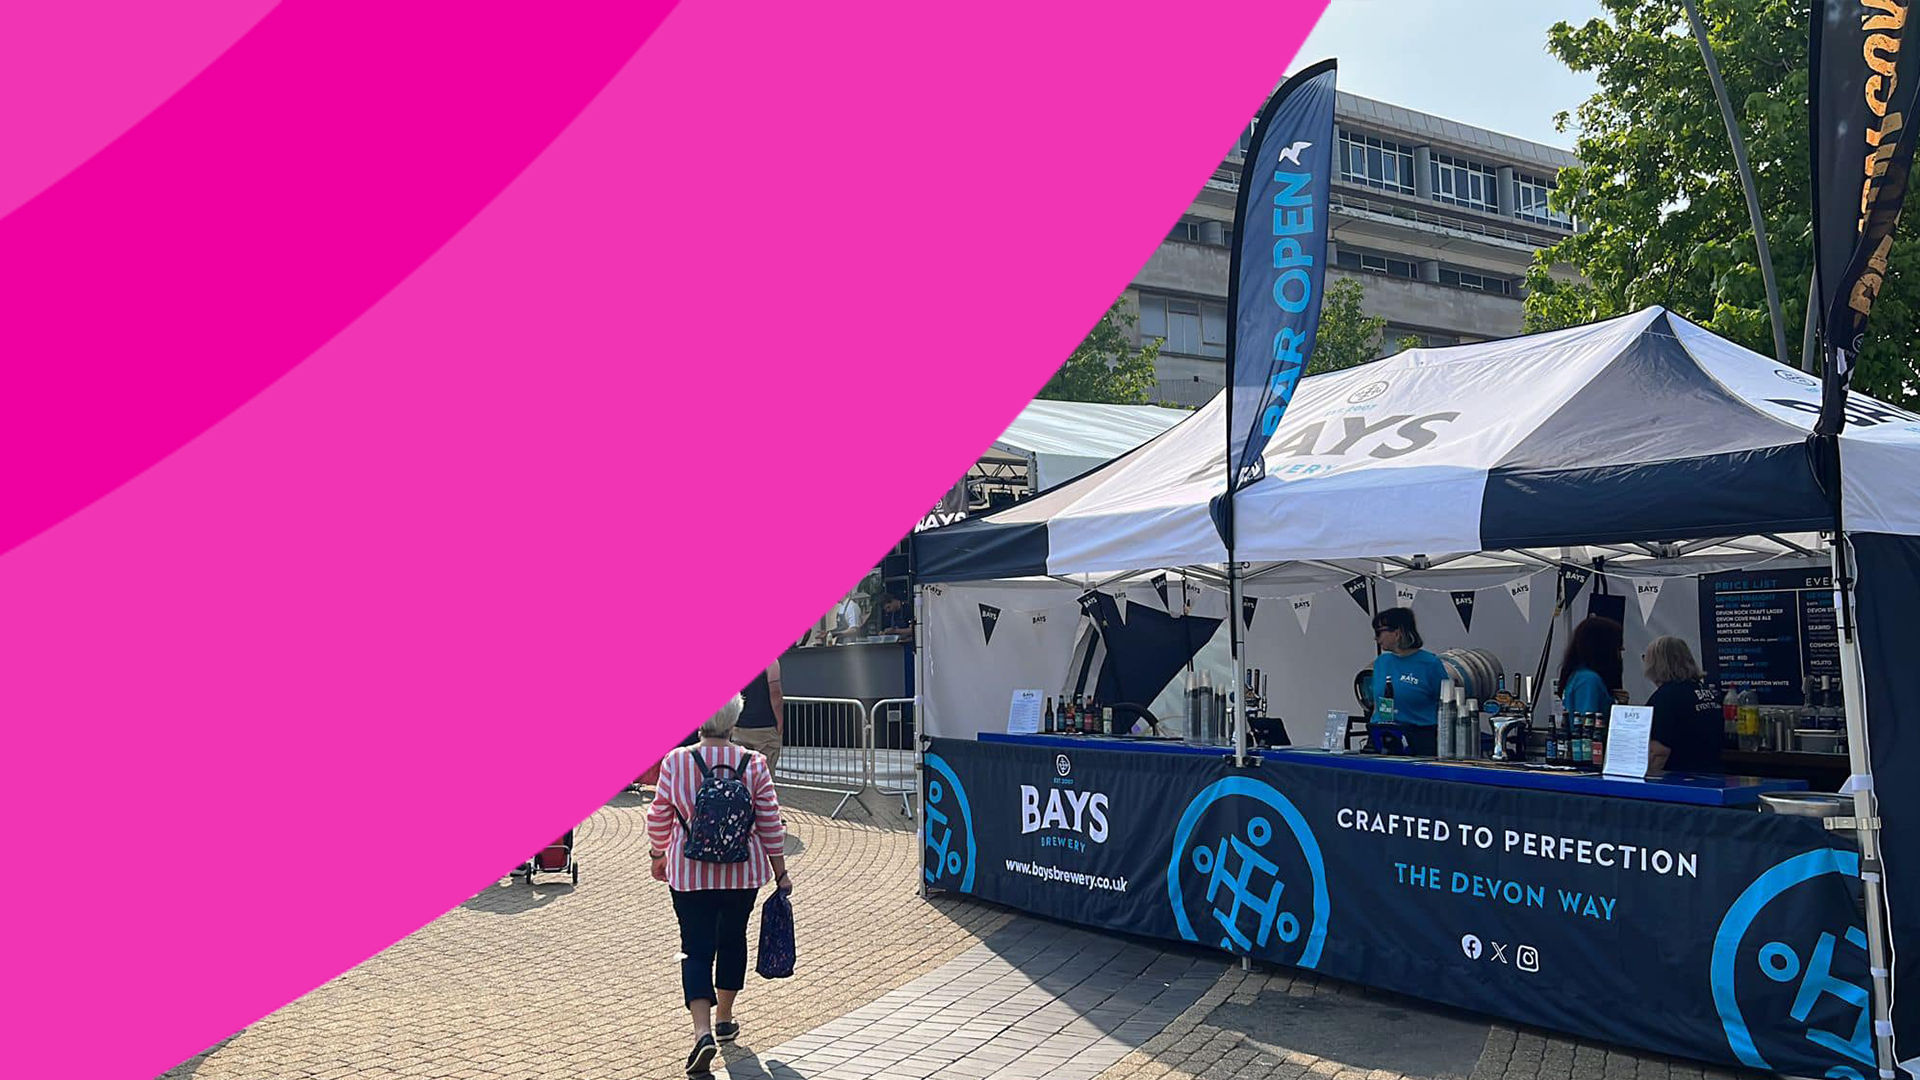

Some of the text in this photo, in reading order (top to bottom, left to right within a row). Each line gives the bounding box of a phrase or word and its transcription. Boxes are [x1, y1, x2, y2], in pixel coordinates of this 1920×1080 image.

[1273, 170, 1314, 314] OPEN
[1565, 570, 1585, 583] BAYS
[1349, 582, 1366, 594] BAYS
[1511, 583, 1529, 596] BAYS
[1638, 584, 1659, 594] BAYS
[1715, 578, 1777, 590] PRICE LIST
[1114, 591, 1126, 600] BAYS
[1398, 589, 1413, 600] BAYS
[1294, 600, 1311, 611] BAYS
[1454, 596, 1473, 606] BAYS
[981, 609, 997, 621] BAYS
[1032, 615, 1046, 624] BAYS
[1400, 674, 1418, 685] BAYS
[1694, 689, 1715, 700] BAYS
[1020, 784, 1109, 843] BAYS
[1041, 836, 1086, 853] BREWERY
[1337, 807, 1697, 878] CRAFTED TO PERFECTION
[1006, 859, 1128, 893] www.baysbrewery.co.uk
[1394, 862, 1616, 921] THE DEVON WAY
